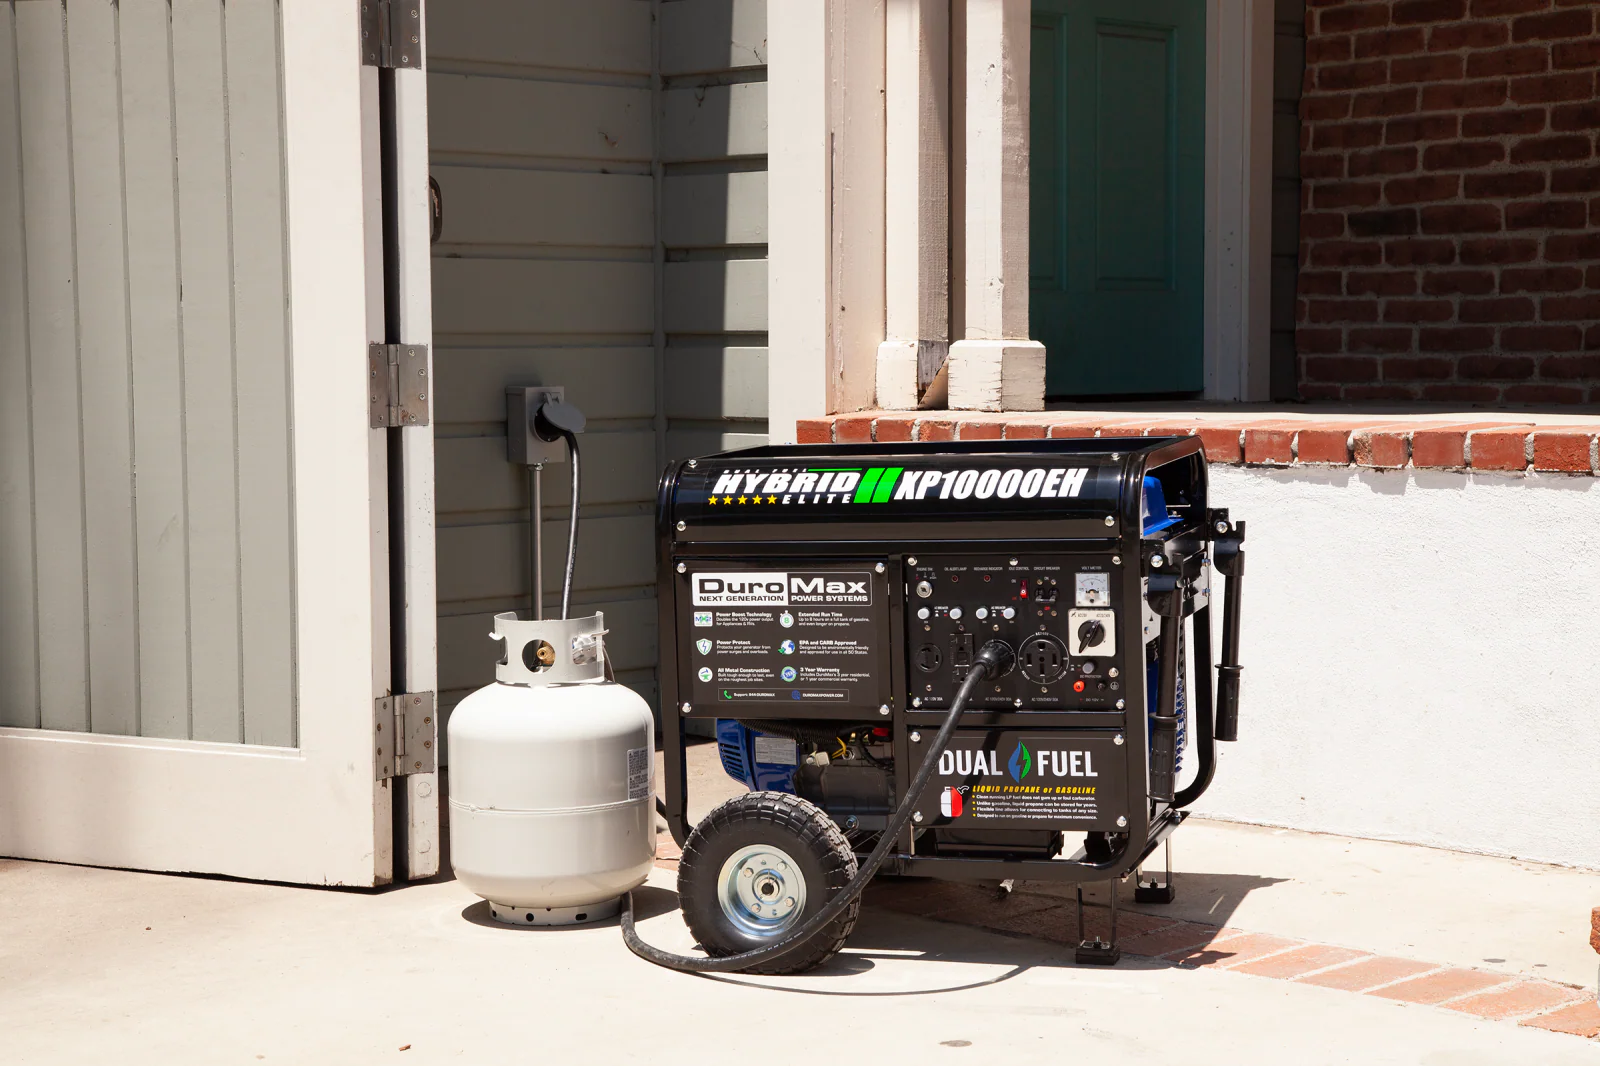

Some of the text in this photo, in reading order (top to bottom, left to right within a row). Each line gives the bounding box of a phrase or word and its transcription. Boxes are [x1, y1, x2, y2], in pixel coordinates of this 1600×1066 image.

[712, 472, 861, 494] HYBRID
[893, 468, 1089, 500] XP10000EH
[782, 494, 851, 504] ELITE
[938, 750, 1098, 776] DUAL FUEL
